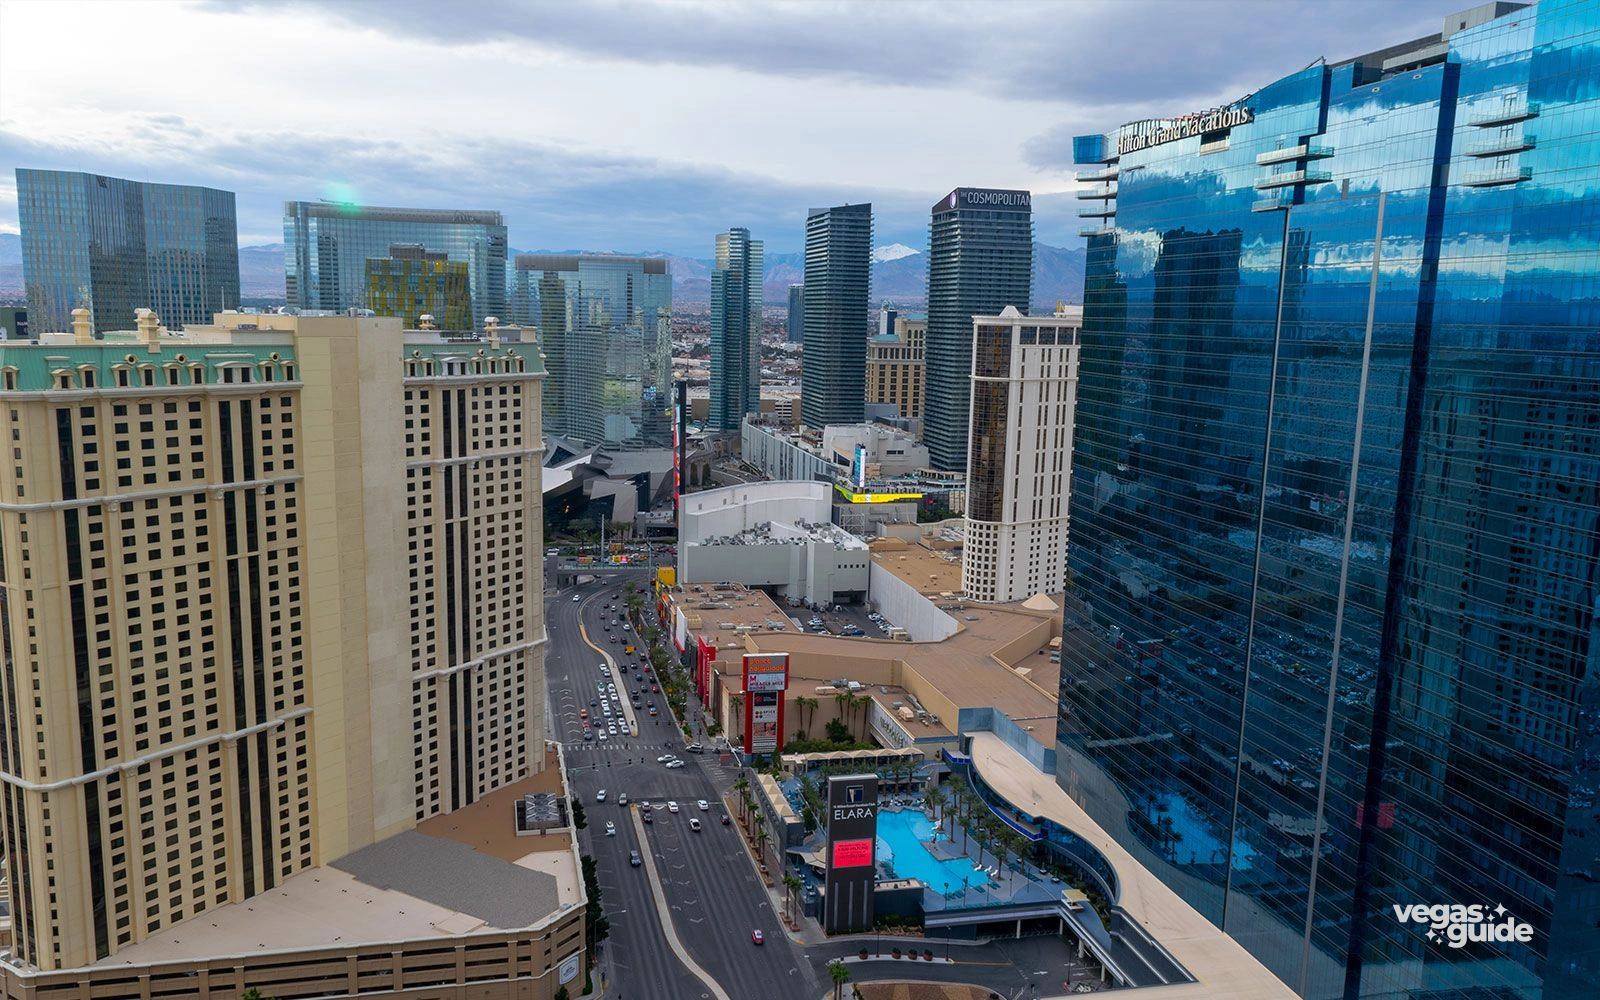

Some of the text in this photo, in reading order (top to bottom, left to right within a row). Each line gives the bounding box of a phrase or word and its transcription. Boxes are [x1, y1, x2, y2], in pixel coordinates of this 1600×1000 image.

[1118, 106, 1248, 155] Hilton Grand Vacations
[967, 192, 1031, 205] COSMOPOLITAN
[834, 809, 873, 820] ELARA
